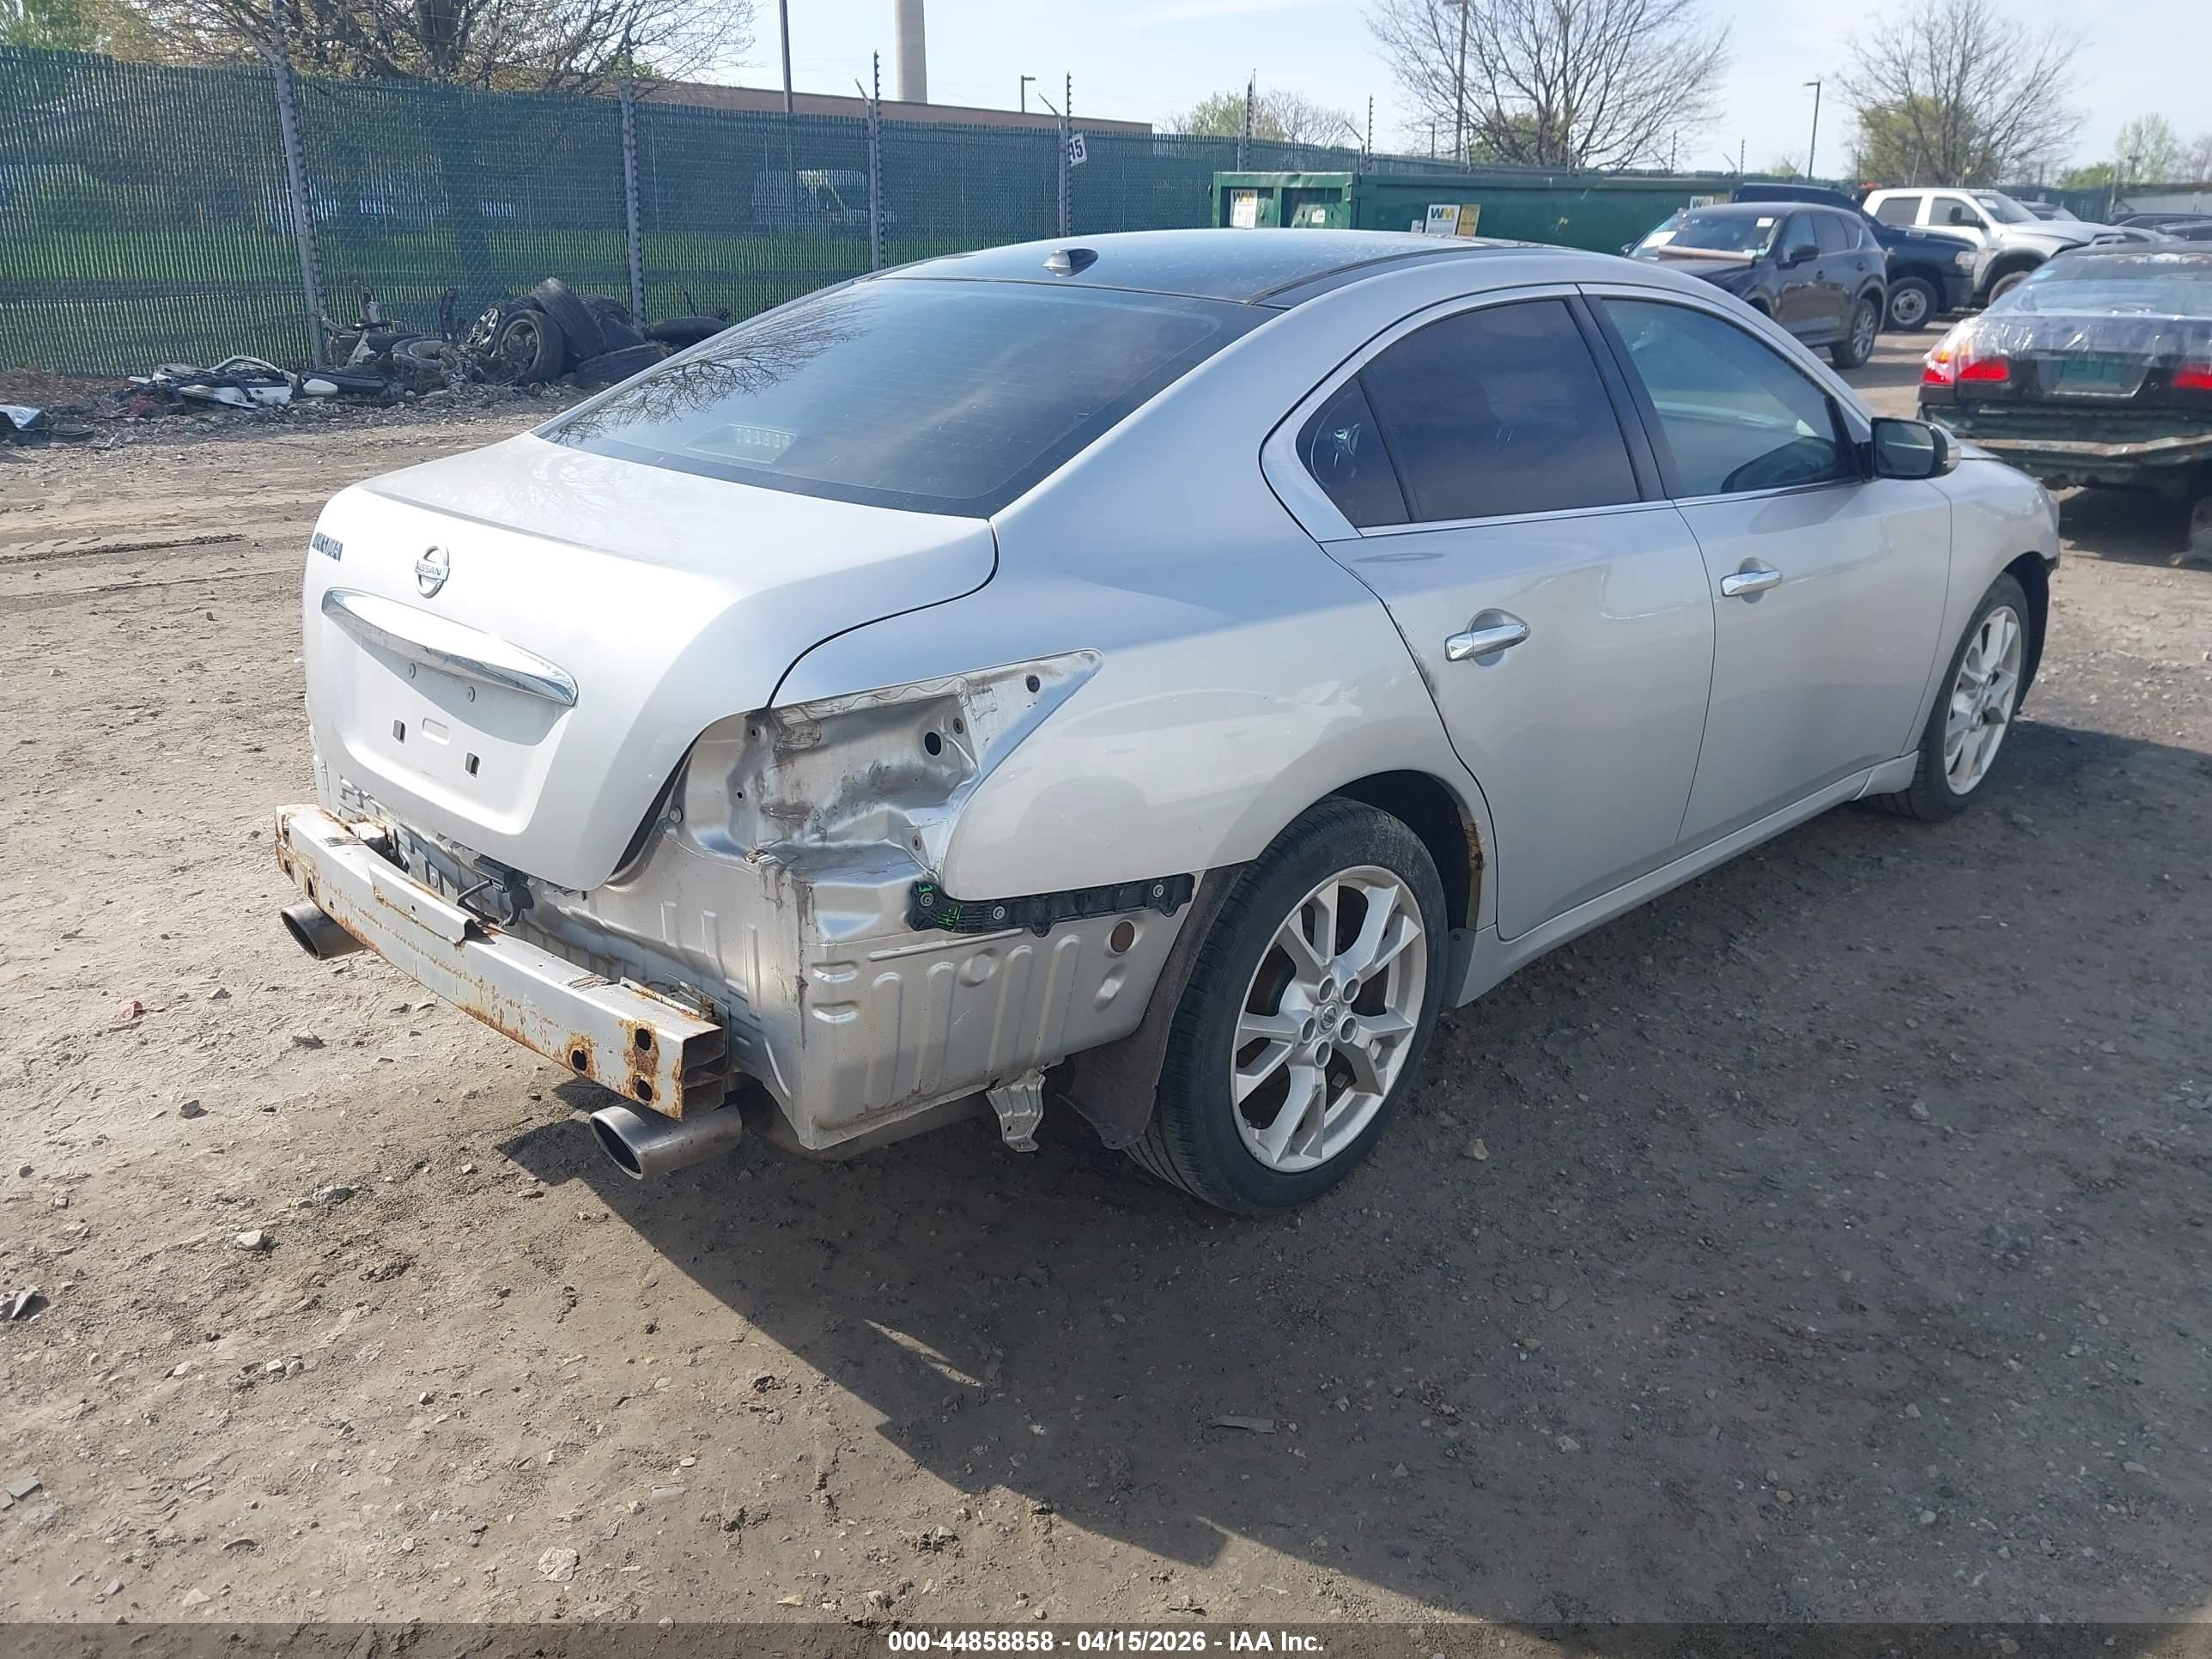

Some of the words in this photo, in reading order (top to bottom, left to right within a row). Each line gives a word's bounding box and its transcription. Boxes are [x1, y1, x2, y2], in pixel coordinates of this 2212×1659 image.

[1070, 138, 1084, 160] 15
[1431, 207, 1455, 219] WM
[416, 558, 443, 577] NISSAN
